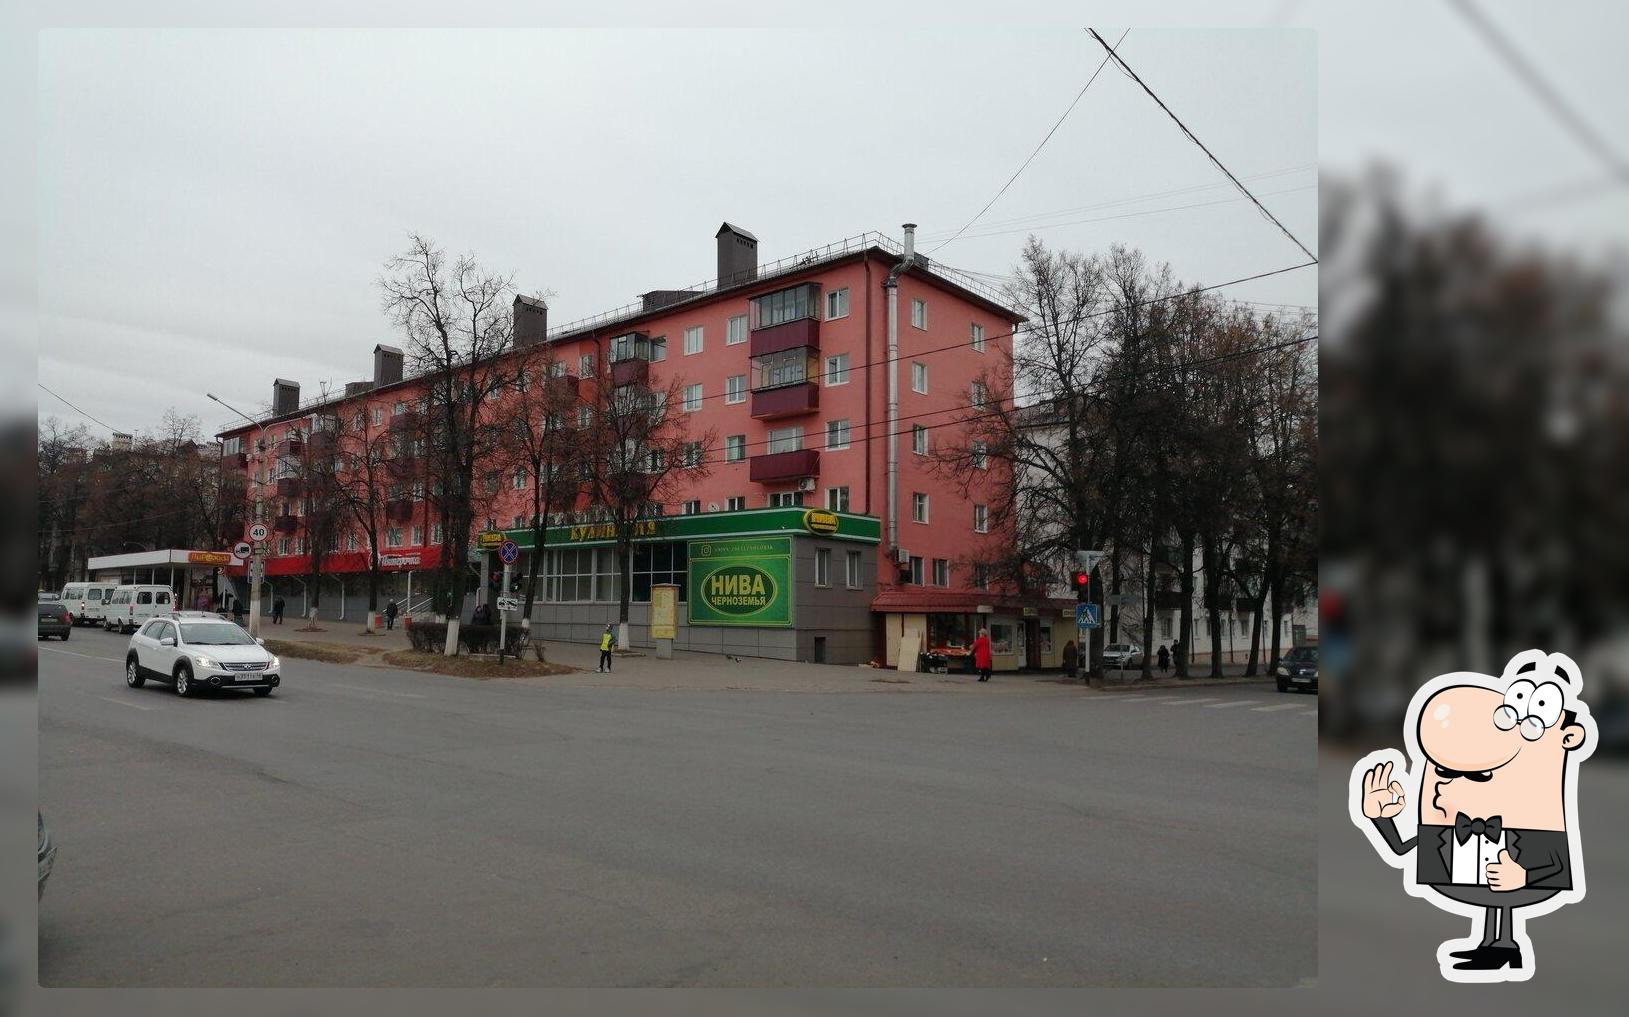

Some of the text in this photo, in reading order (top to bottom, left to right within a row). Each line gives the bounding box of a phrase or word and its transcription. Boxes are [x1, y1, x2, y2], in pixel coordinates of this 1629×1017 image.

[252, 528, 265, 537] 40
[711, 574, 766, 596] НИВА
[711, 596, 766, 606] ЧЕРНОЗЕМЬЯ
